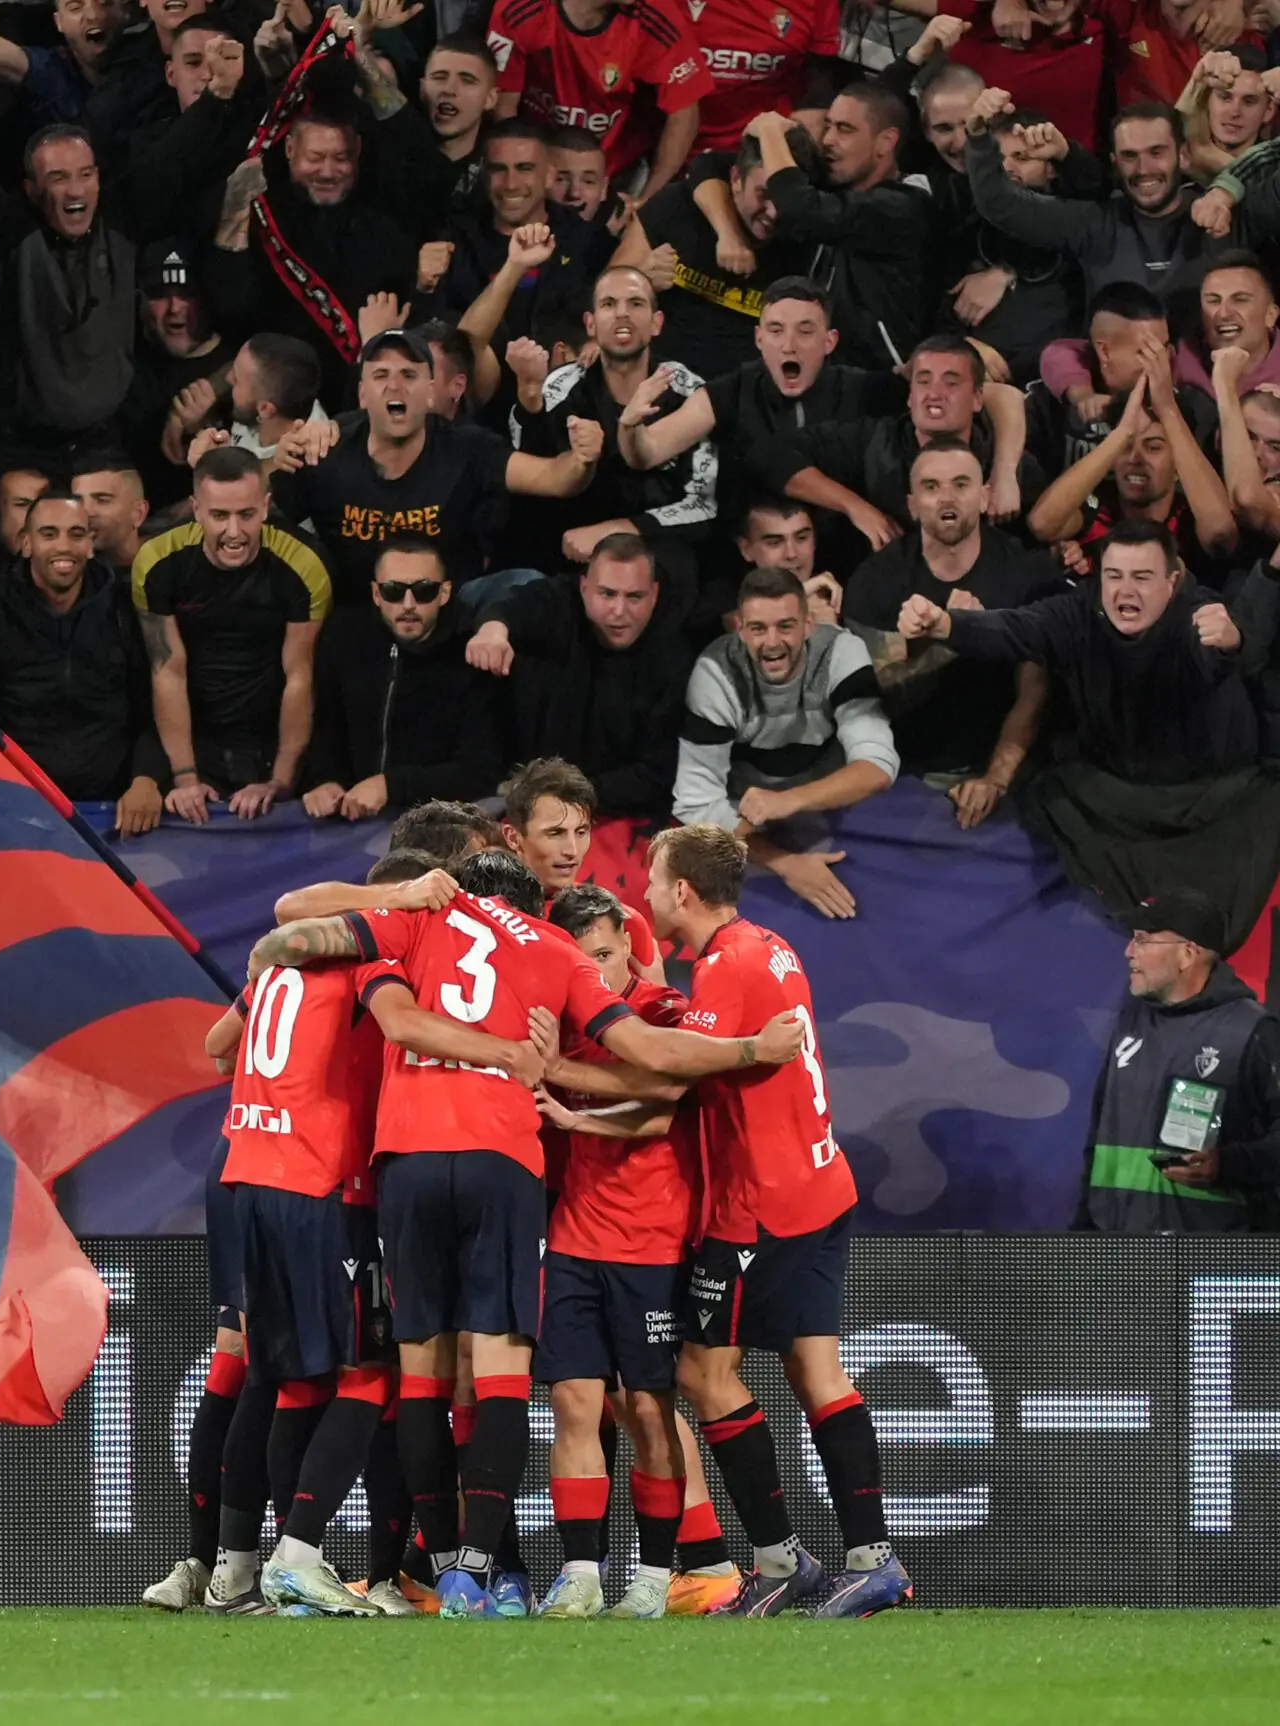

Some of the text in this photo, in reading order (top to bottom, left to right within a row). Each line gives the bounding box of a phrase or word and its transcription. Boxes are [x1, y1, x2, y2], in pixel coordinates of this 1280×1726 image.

[440, 909, 497, 1023] 3
[245, 966, 304, 1079] 10
[230, 1103, 291, 1134] DIGI
[647, 1333, 659, 1344] de
